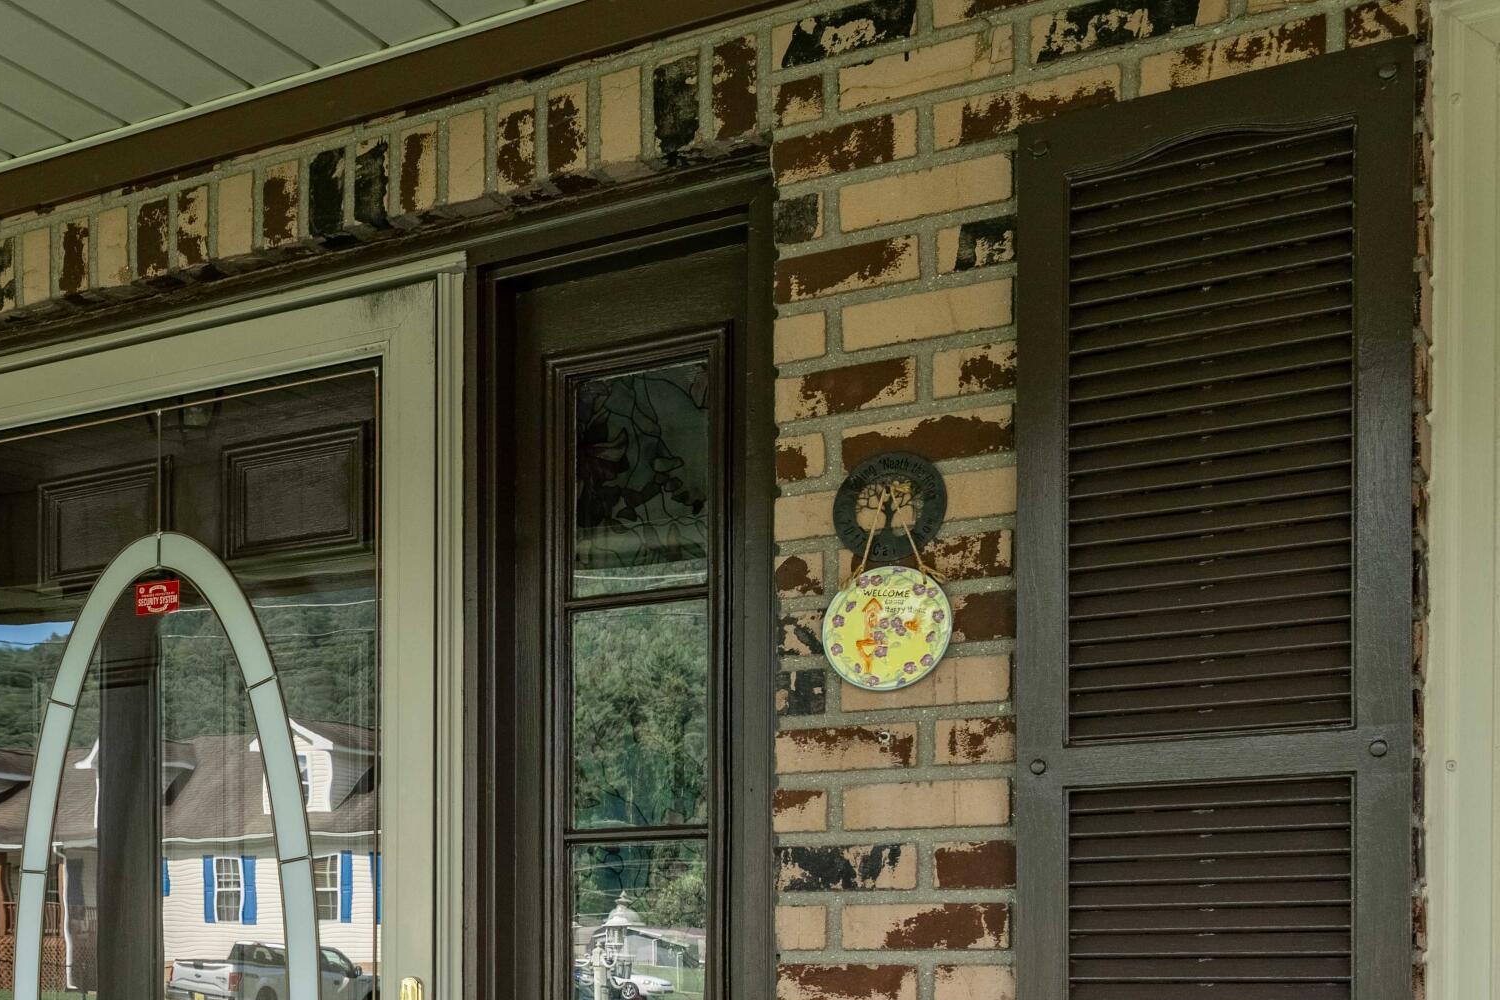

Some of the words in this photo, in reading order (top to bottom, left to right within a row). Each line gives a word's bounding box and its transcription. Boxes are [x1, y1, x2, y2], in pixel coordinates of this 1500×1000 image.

[863, 589, 911, 598] WELCOME
[138, 596, 159, 607] SECURITY
[159, 594, 178, 605] SYSTEM
